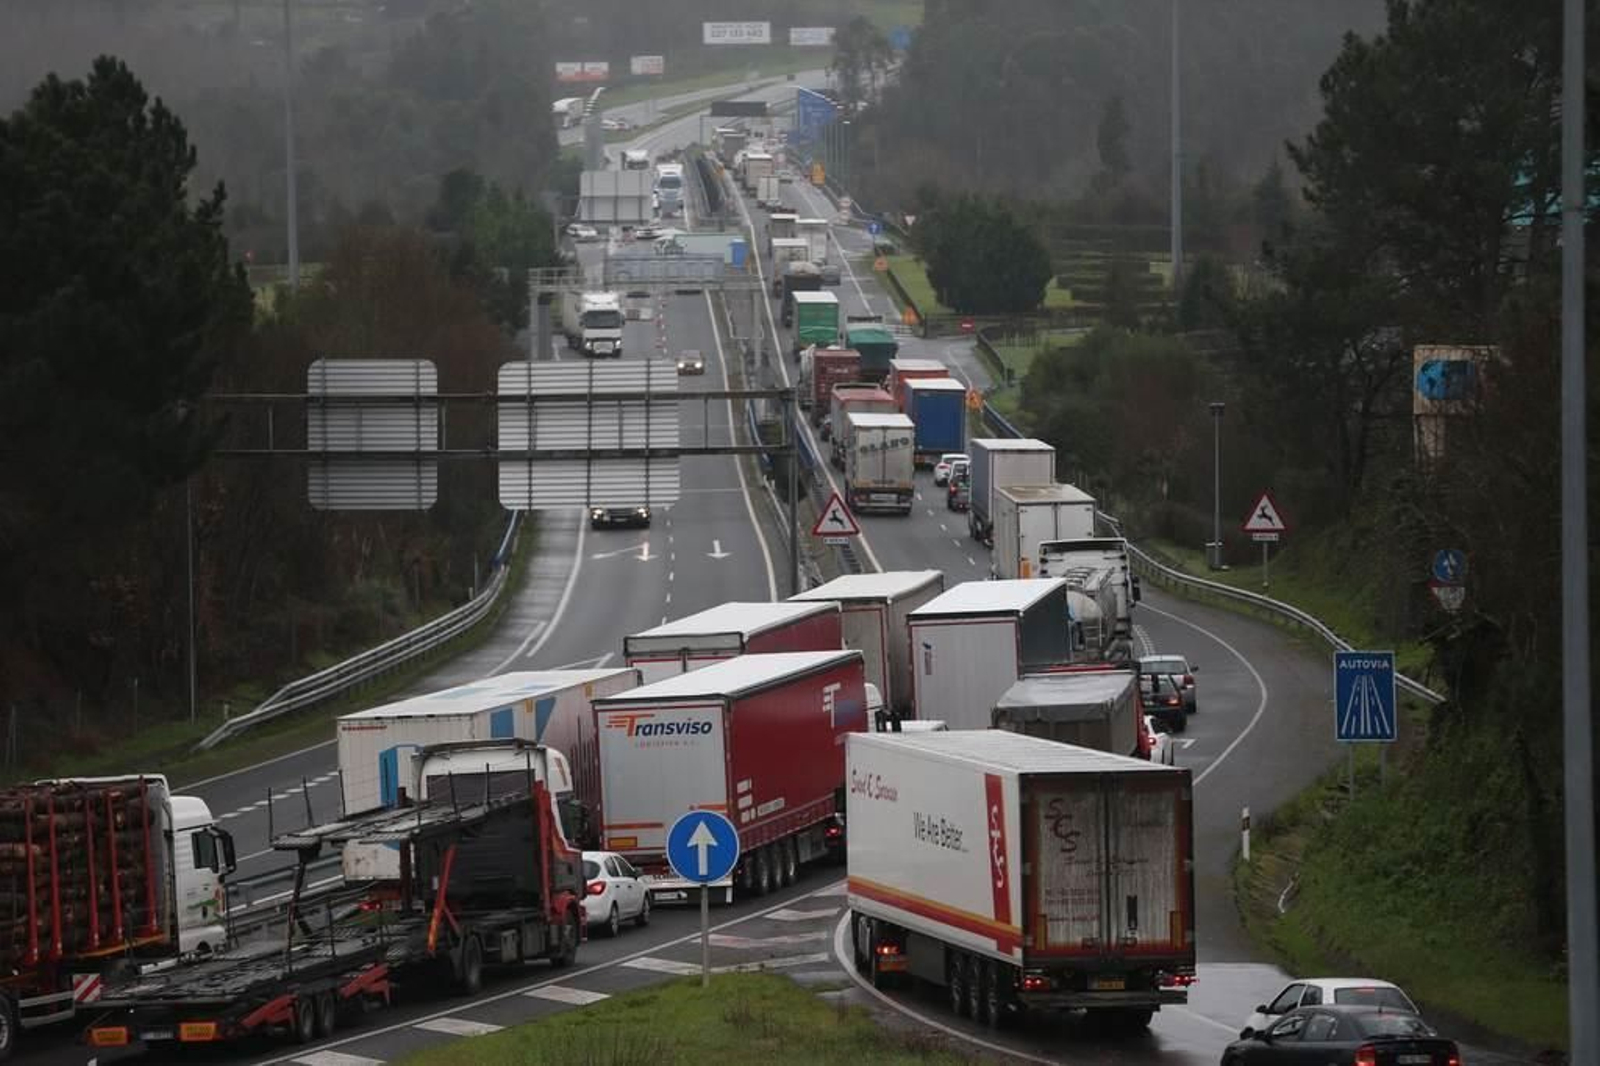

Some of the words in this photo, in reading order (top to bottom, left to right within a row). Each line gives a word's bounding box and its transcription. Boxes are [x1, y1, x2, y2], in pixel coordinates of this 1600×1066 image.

[606, 713, 713, 738] Transviso
[913, 812, 926, 842] We
[926, 815, 940, 846] Are
